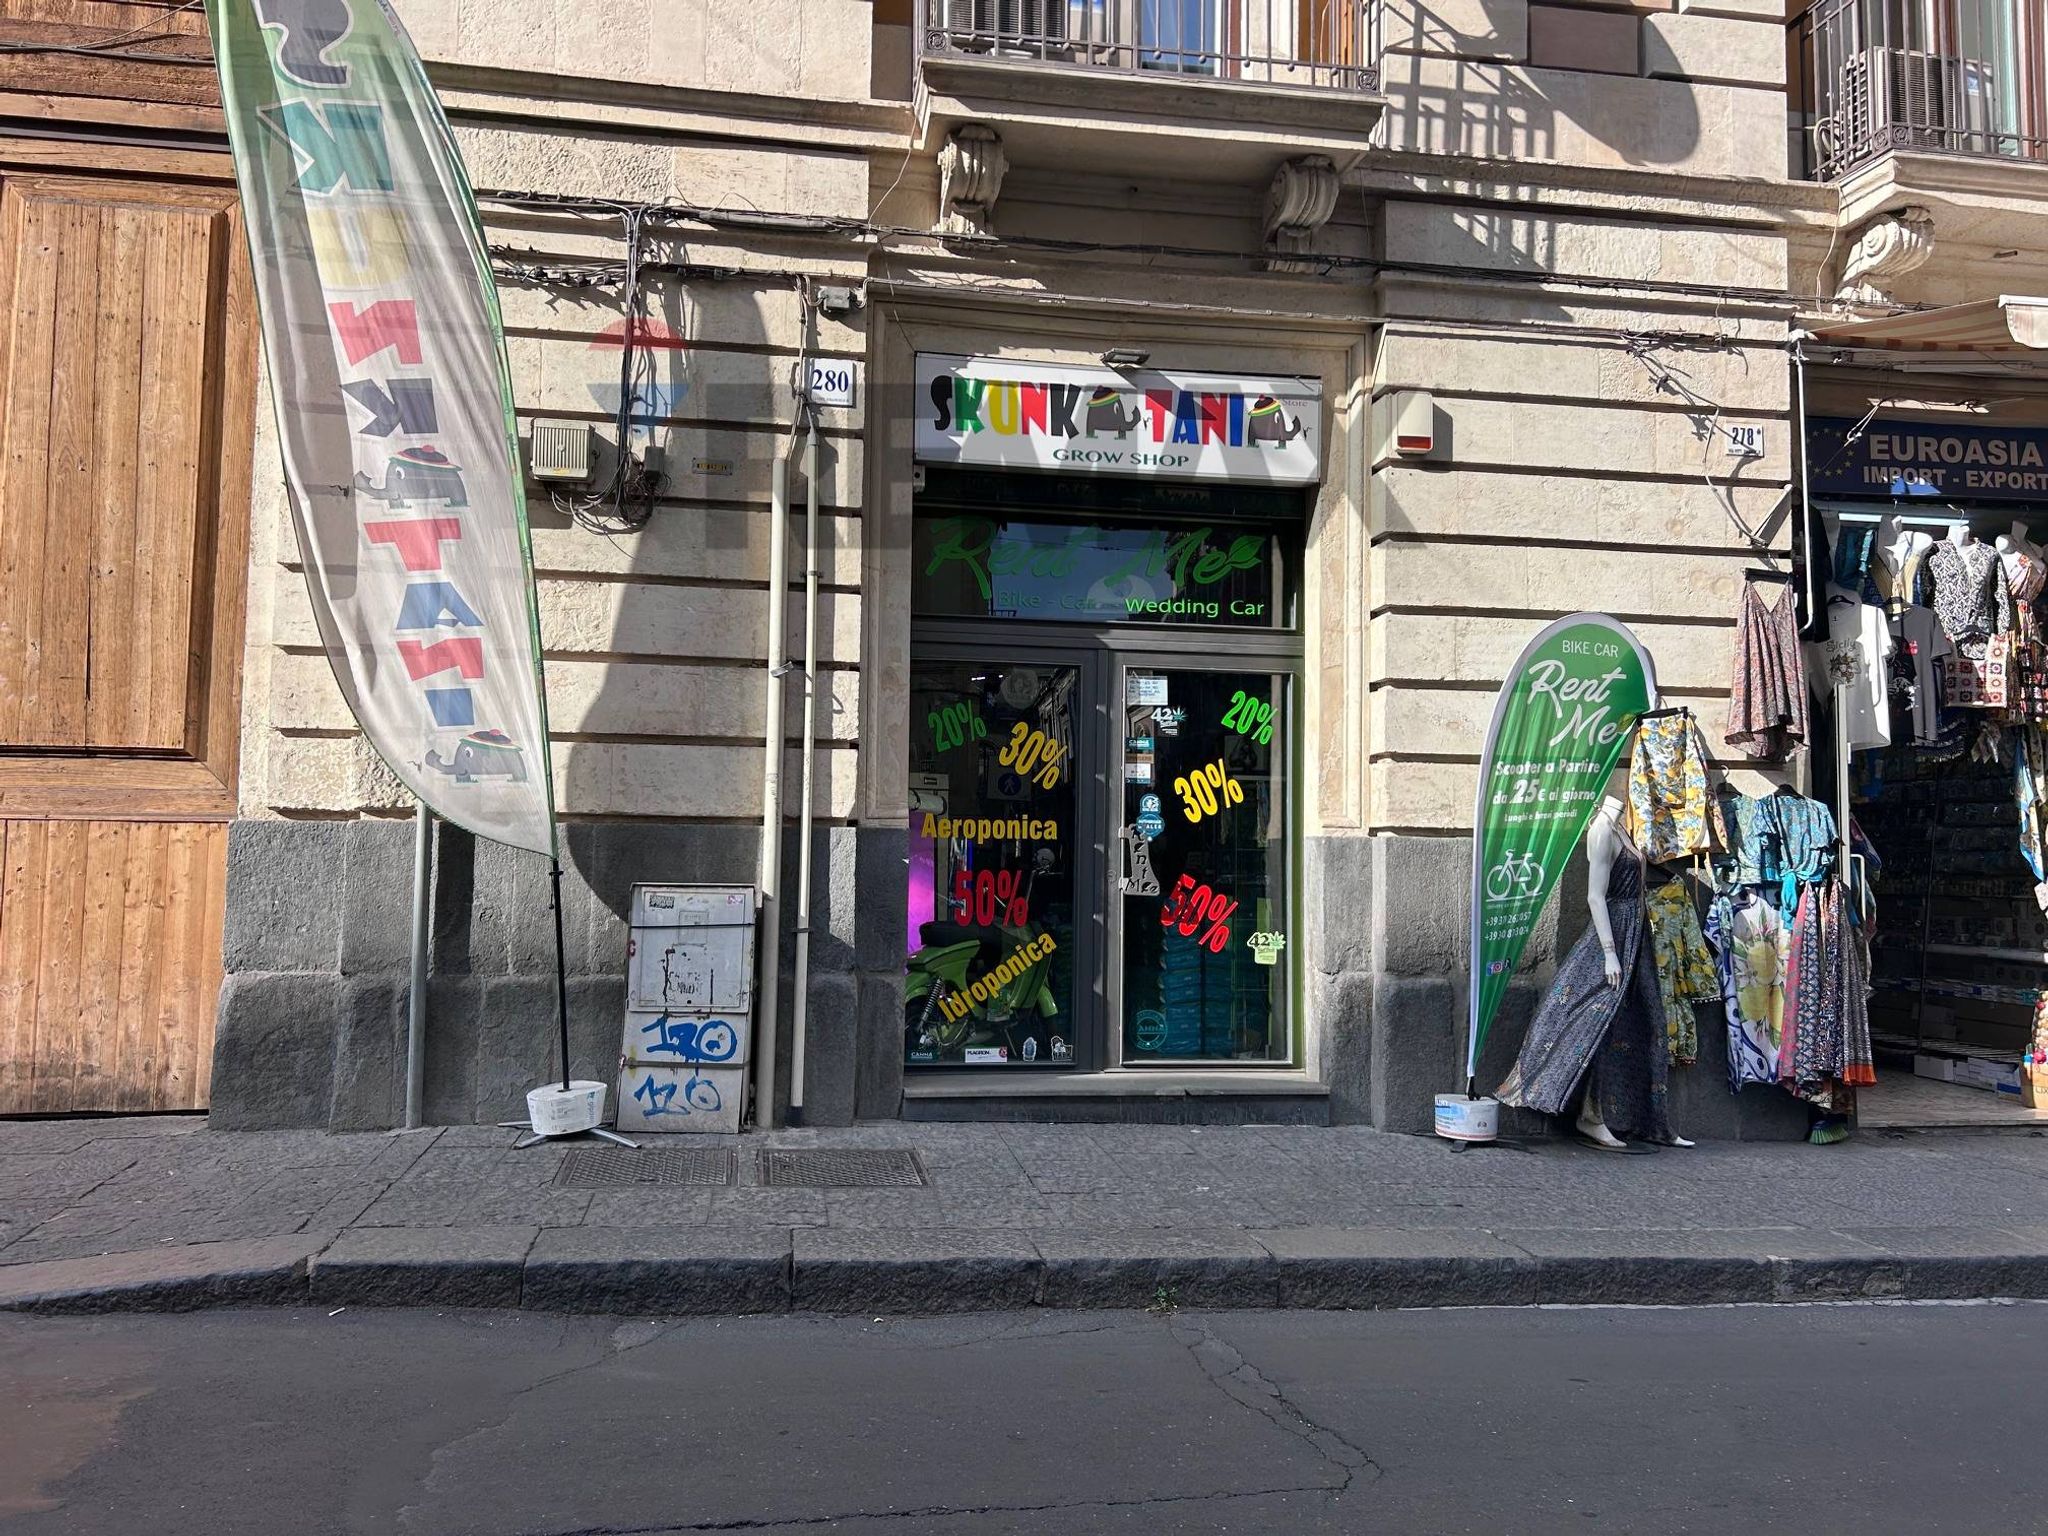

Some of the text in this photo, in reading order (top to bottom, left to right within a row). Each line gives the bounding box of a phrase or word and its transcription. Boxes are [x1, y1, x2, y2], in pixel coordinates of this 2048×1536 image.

[812, 369, 849, 392] 280
[1732, 427, 1754, 446] 278
[1869, 434, 2044, 467] EUROASIA
[1053, 448, 1189, 467] GROW SHOP
[1863, 466, 1946, 487] IMPORT
[1965, 470, 2048, 491] EXPORT
[925, 515, 1111, 602] Rent
[1125, 598, 1220, 619] Wedding
[1230, 599, 1265, 616] Car
[1562, 640, 1618, 657] BIKE CAR
[1527, 659, 1627, 718] Rent
[928, 700, 987, 753] 20%
[1220, 690, 1279, 746] 20%
[1549, 703, 1620, 746] Me
[999, 722, 1067, 790] 30%
[1496, 758, 1600, 776] Scooter a Partire
[1174, 759, 1244, 824] 30%
[1493, 790, 1508, 805] da
[1549, 787, 1559, 801] al
[1562, 787, 1596, 803] giorno
[920, 813, 1057, 845] Aeroponica
[954, 869, 1029, 928] 50%
[1160, 873, 1240, 953] 50%
[936, 932, 1057, 1025] Idroponica
